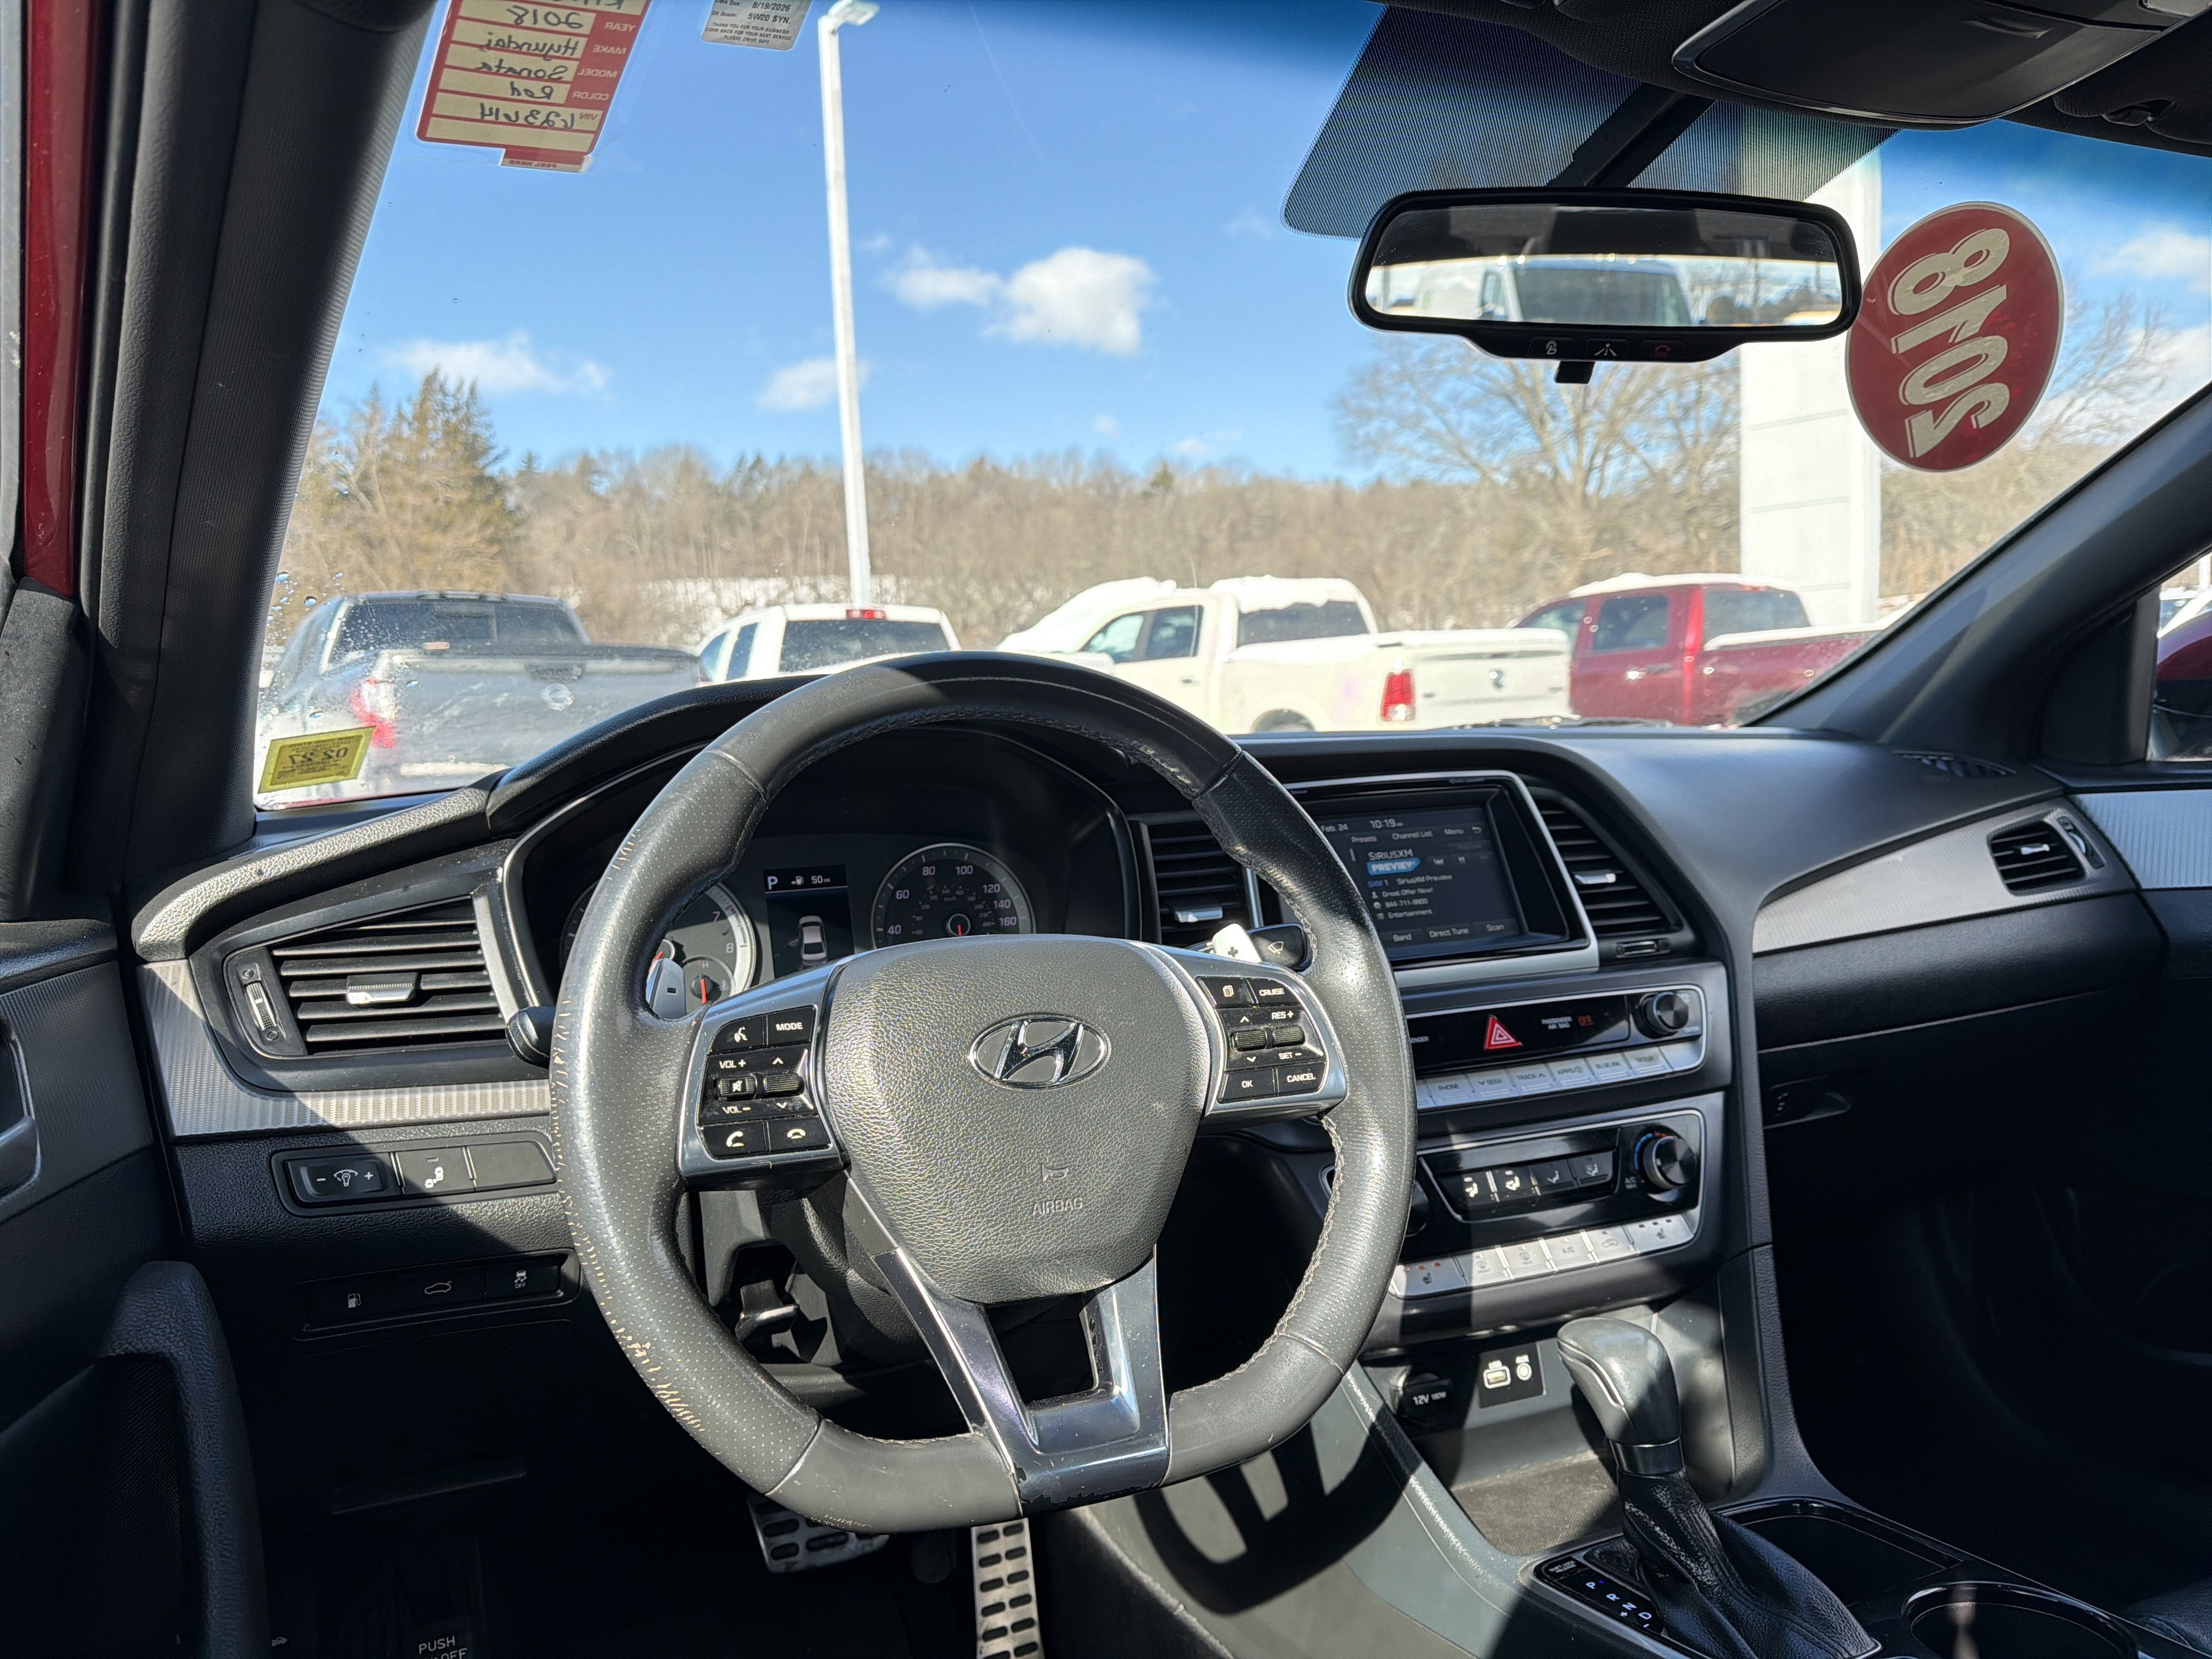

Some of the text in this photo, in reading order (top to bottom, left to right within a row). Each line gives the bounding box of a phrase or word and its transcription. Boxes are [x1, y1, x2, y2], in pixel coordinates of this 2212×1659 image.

[752, 2, 791, 12] 8/19/2026
[748, 13, 770, 21] 5W20
[772, 15, 791, 24] SYN.
[1337, 823, 1348, 832] 24
[922, 866, 935, 877] 80
[955, 865, 973, 876] 100
[767, 876, 778, 890] P
[811, 875, 823, 884] 50
[983, 883, 1001, 894] 120
[896, 889, 910, 900] 60
[993, 899, 1012, 910] 140
[713, 911, 721, 922] 7
[998, 916, 1017, 927] 160
[887, 924, 902, 935] 40
[1486, 924, 1505, 932] Scan
[1392, 933, 1413, 943] Band
[726, 943, 734, 954] 8
[1259, 988, 1285, 997] CRUISE
[1271, 1012, 1286, 1020] RES
[776, 1022, 804, 1031] MODE
[1278, 1052, 1293, 1060] SET
[719, 1060, 737, 1069] VOL
[1286, 1073, 1317, 1083] CANCEL
[722, 1105, 742, 1114] VOL
[1031, 1197, 1083, 1216] AIRBAG
[1413, 1393, 1429, 1406] 12V
[1622, 1602, 1637, 1611] N
[1638, 1612, 1652, 1620] D
[419, 1635, 456, 1655] PUSH
